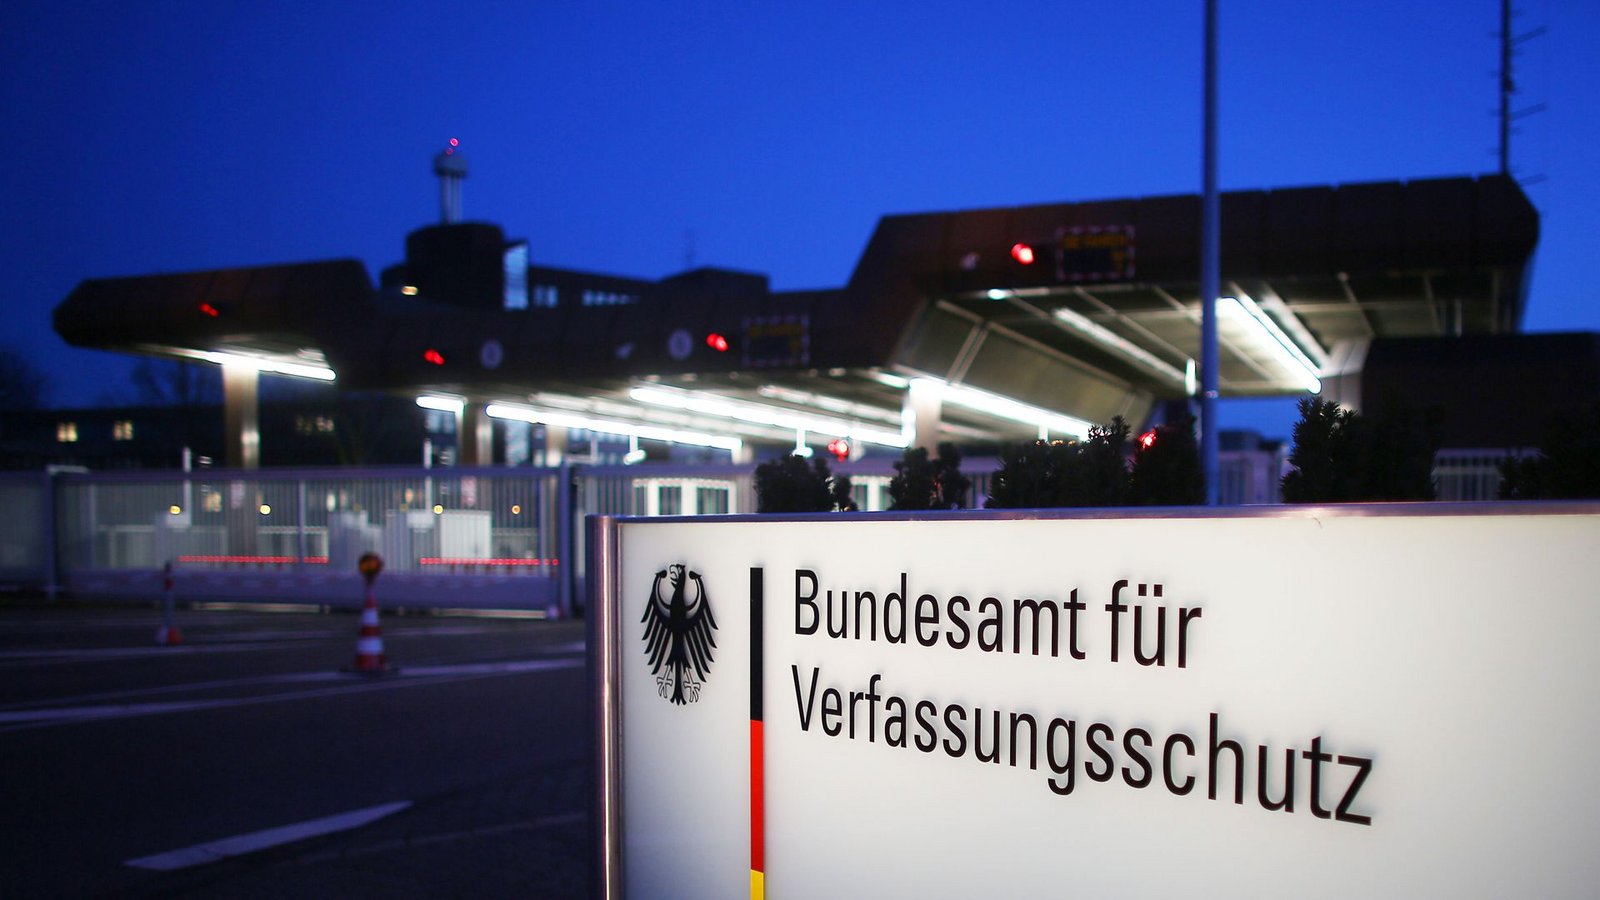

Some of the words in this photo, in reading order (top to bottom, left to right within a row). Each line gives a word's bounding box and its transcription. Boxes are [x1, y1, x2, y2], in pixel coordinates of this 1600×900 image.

[795, 569, 1087, 661] Bundesamt
[1105, 579, 1203, 669] für
[791, 664, 1374, 826] Verfassungsschutz
